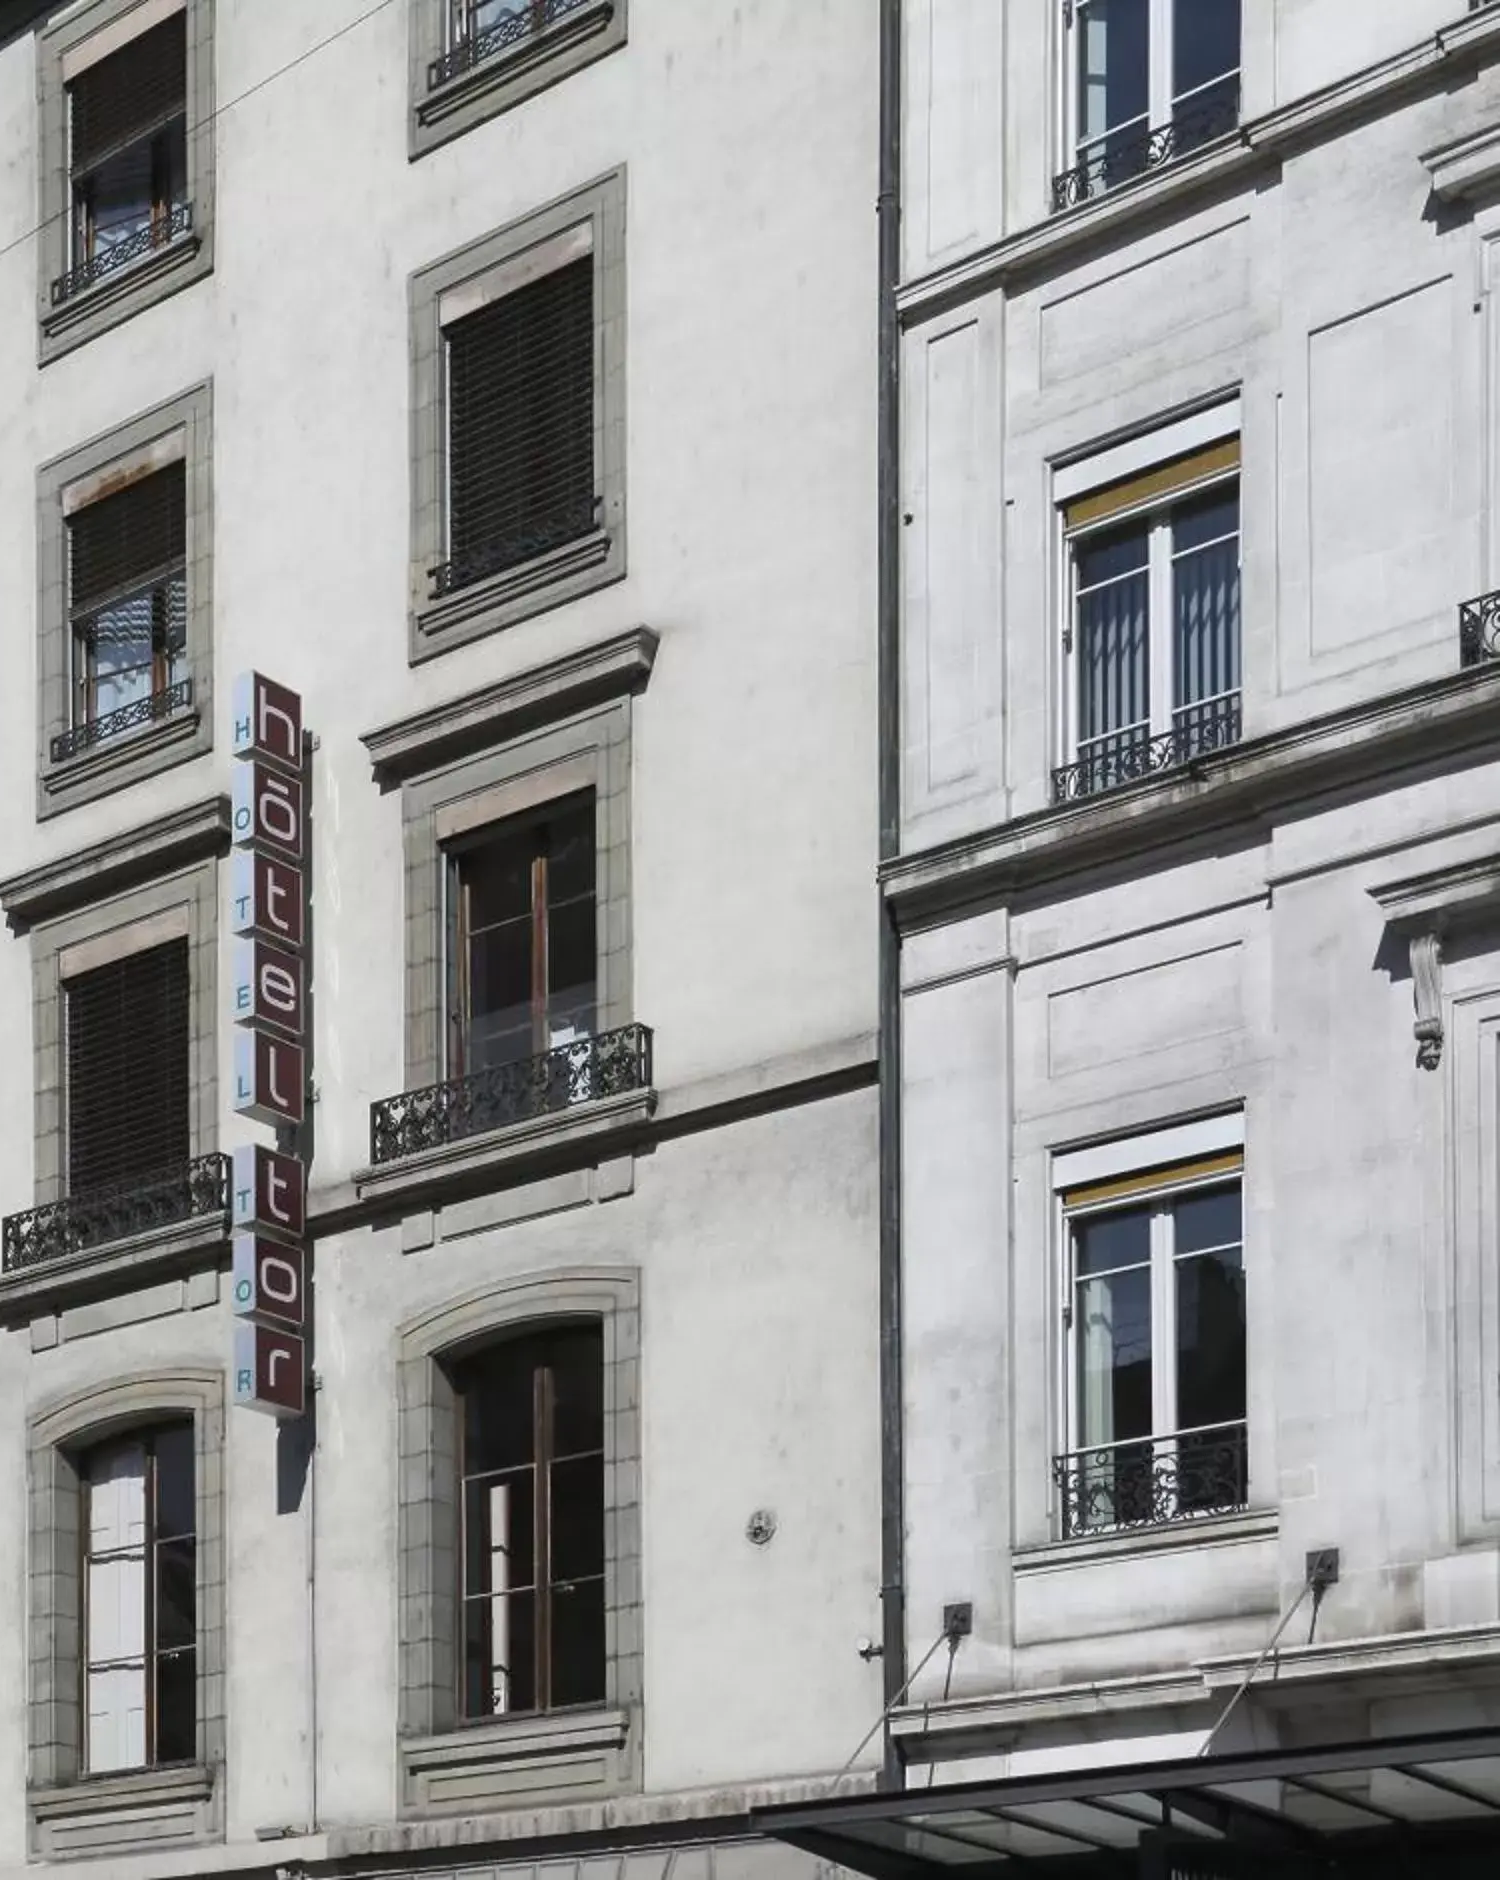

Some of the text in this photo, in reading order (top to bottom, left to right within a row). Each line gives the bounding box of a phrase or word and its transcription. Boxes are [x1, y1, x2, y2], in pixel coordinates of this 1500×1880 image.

[235, 714, 252, 1393] HOTEL TOR
[260, 1160, 297, 1387] tor
